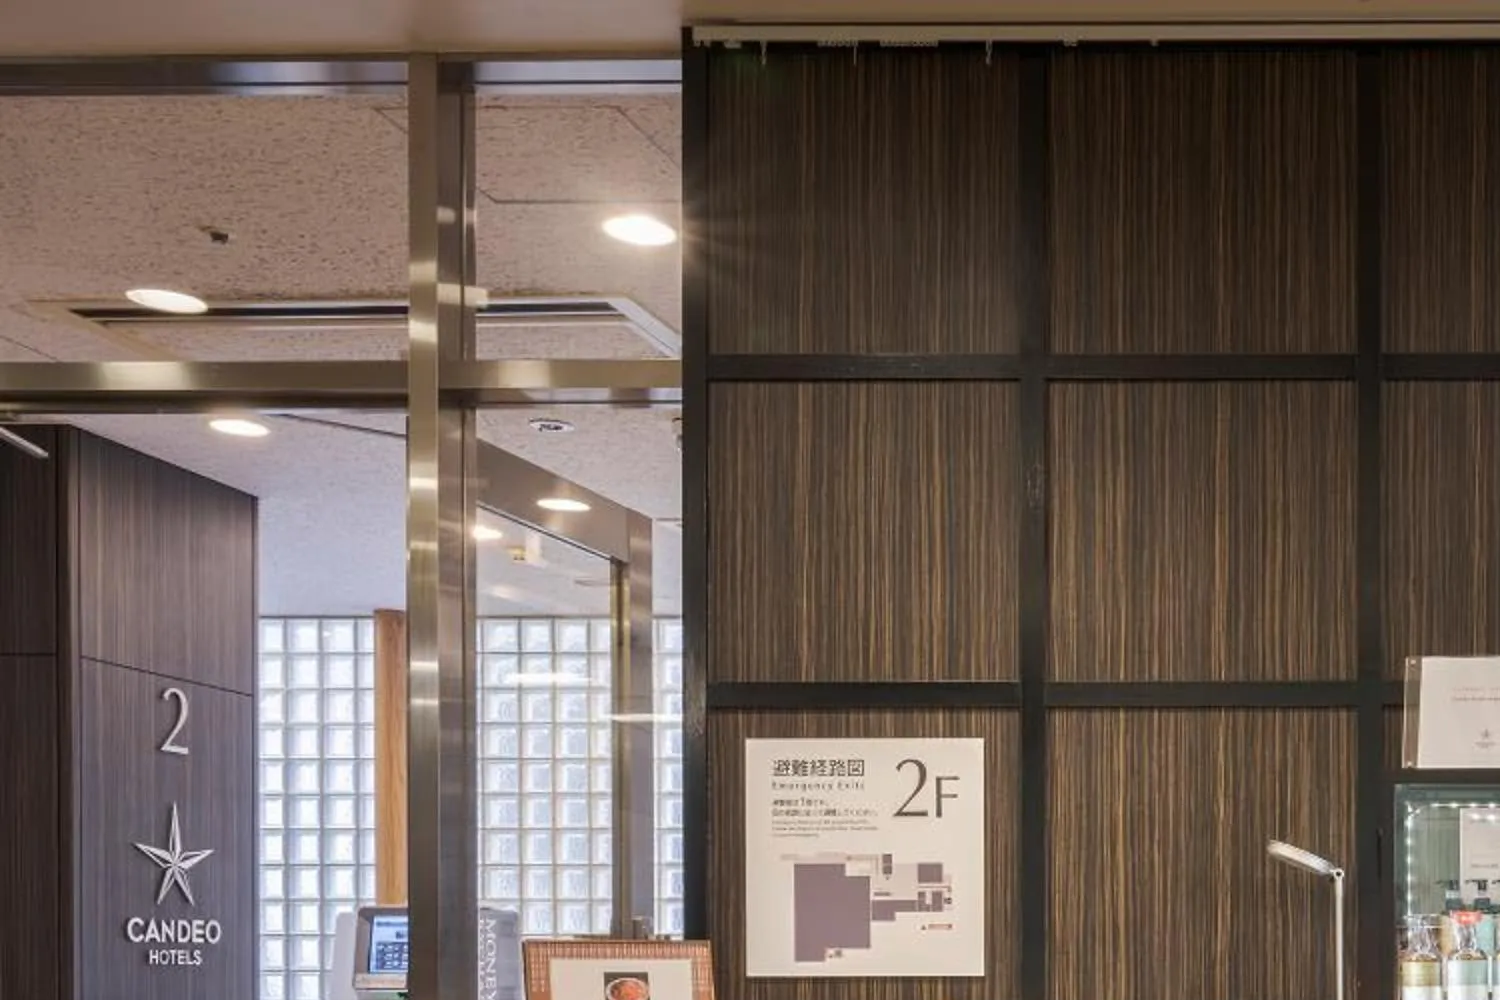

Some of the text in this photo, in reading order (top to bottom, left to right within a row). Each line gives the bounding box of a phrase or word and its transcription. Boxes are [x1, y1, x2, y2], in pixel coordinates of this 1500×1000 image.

[161, 688, 189, 755] 2
[773, 759, 865, 777] 避難経路図
[893, 759, 961, 818] 2F
[126, 916, 223, 944] CANDEO
[149, 949, 202, 965] HOTELS
